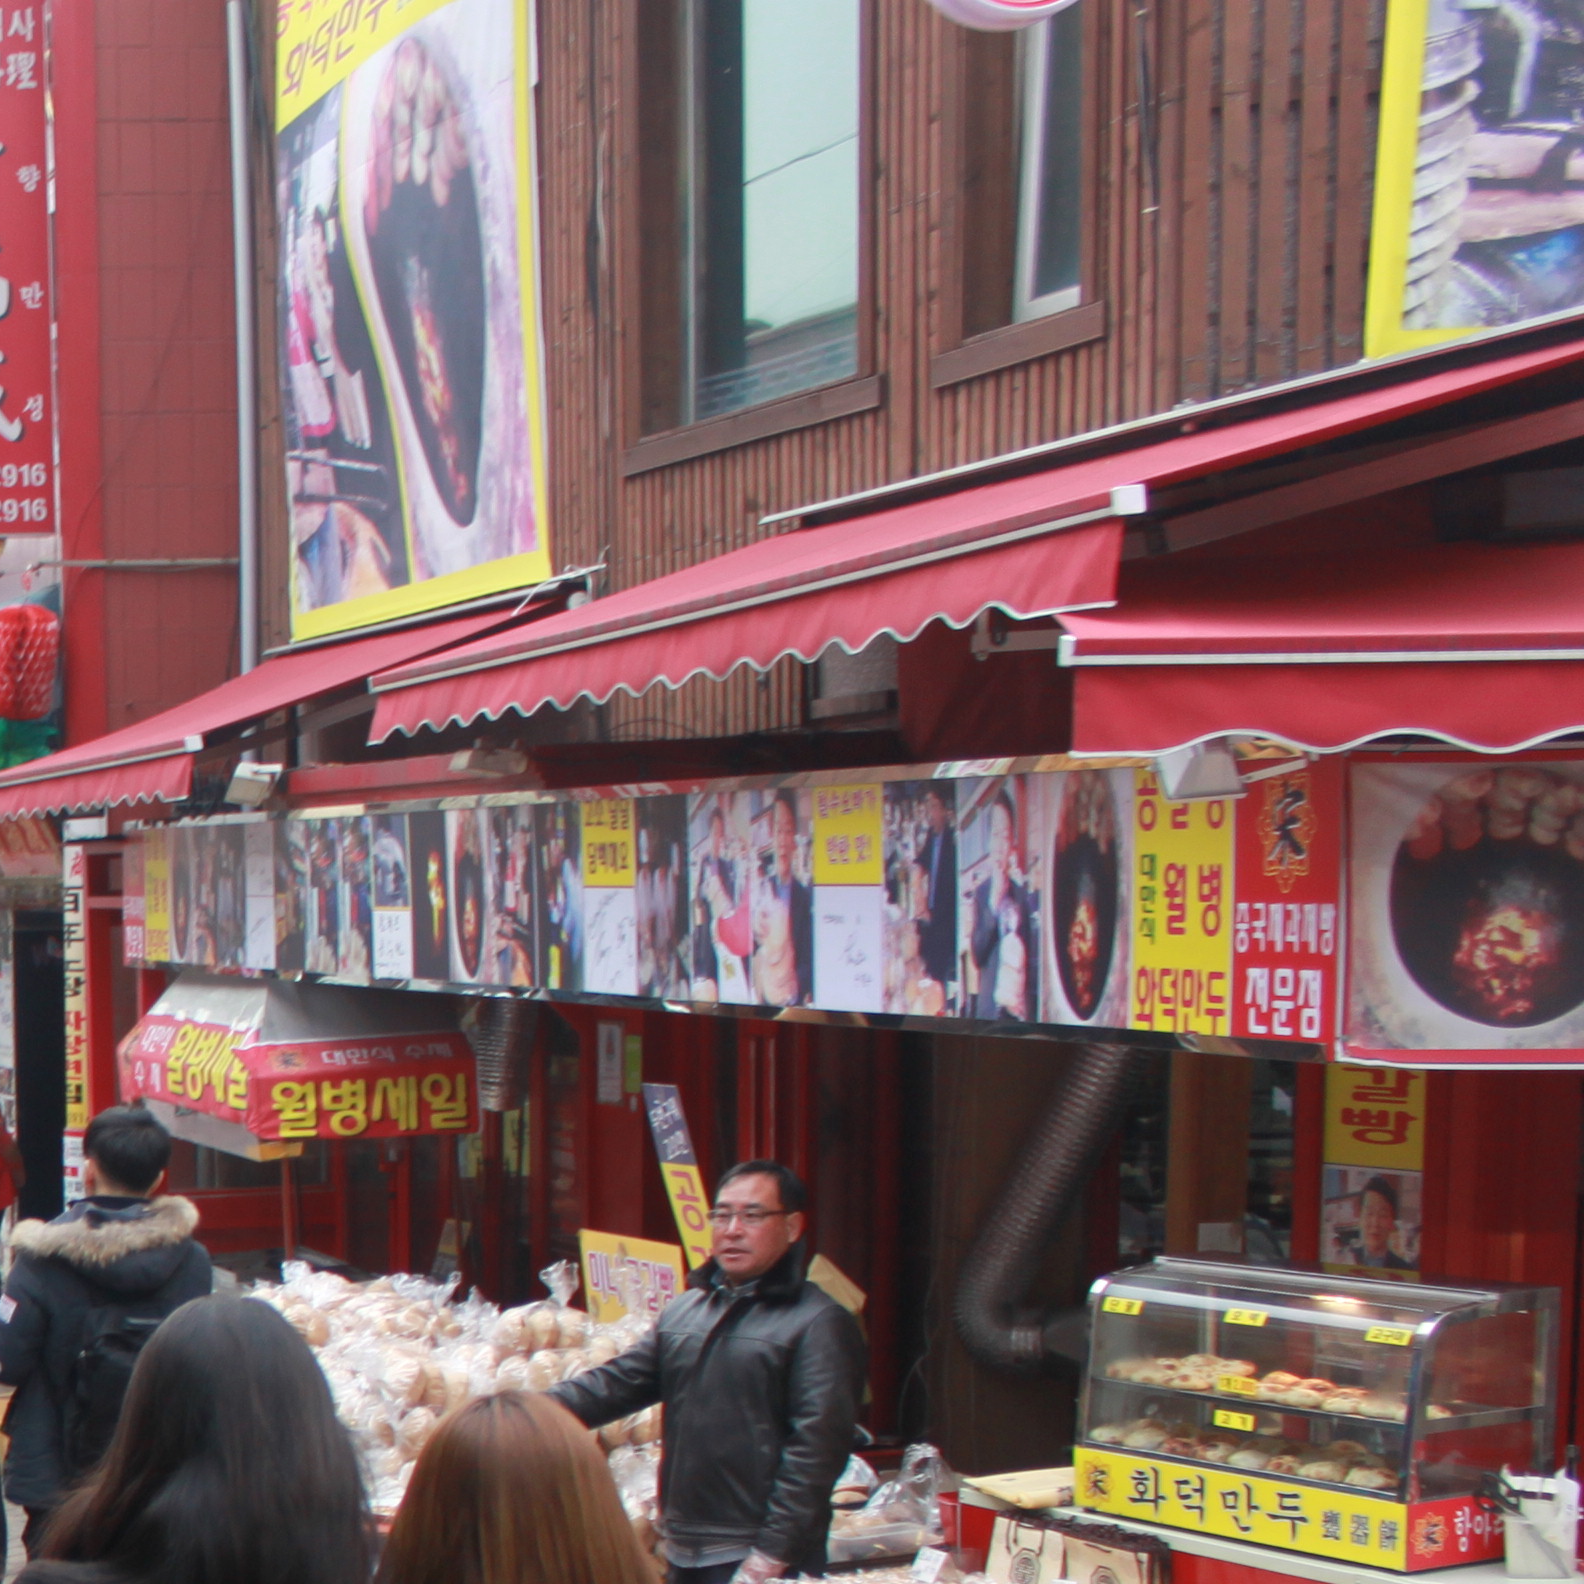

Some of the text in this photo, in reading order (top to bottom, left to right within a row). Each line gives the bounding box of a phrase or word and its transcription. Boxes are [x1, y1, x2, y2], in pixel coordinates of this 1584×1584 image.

[1164, 863, 1223, 937] 월병
[1245, 968, 1322, 1038] 전문점
[271, 1073, 469, 1138] 월병세일
[1127, 1465, 1309, 1542] 화덕만두
